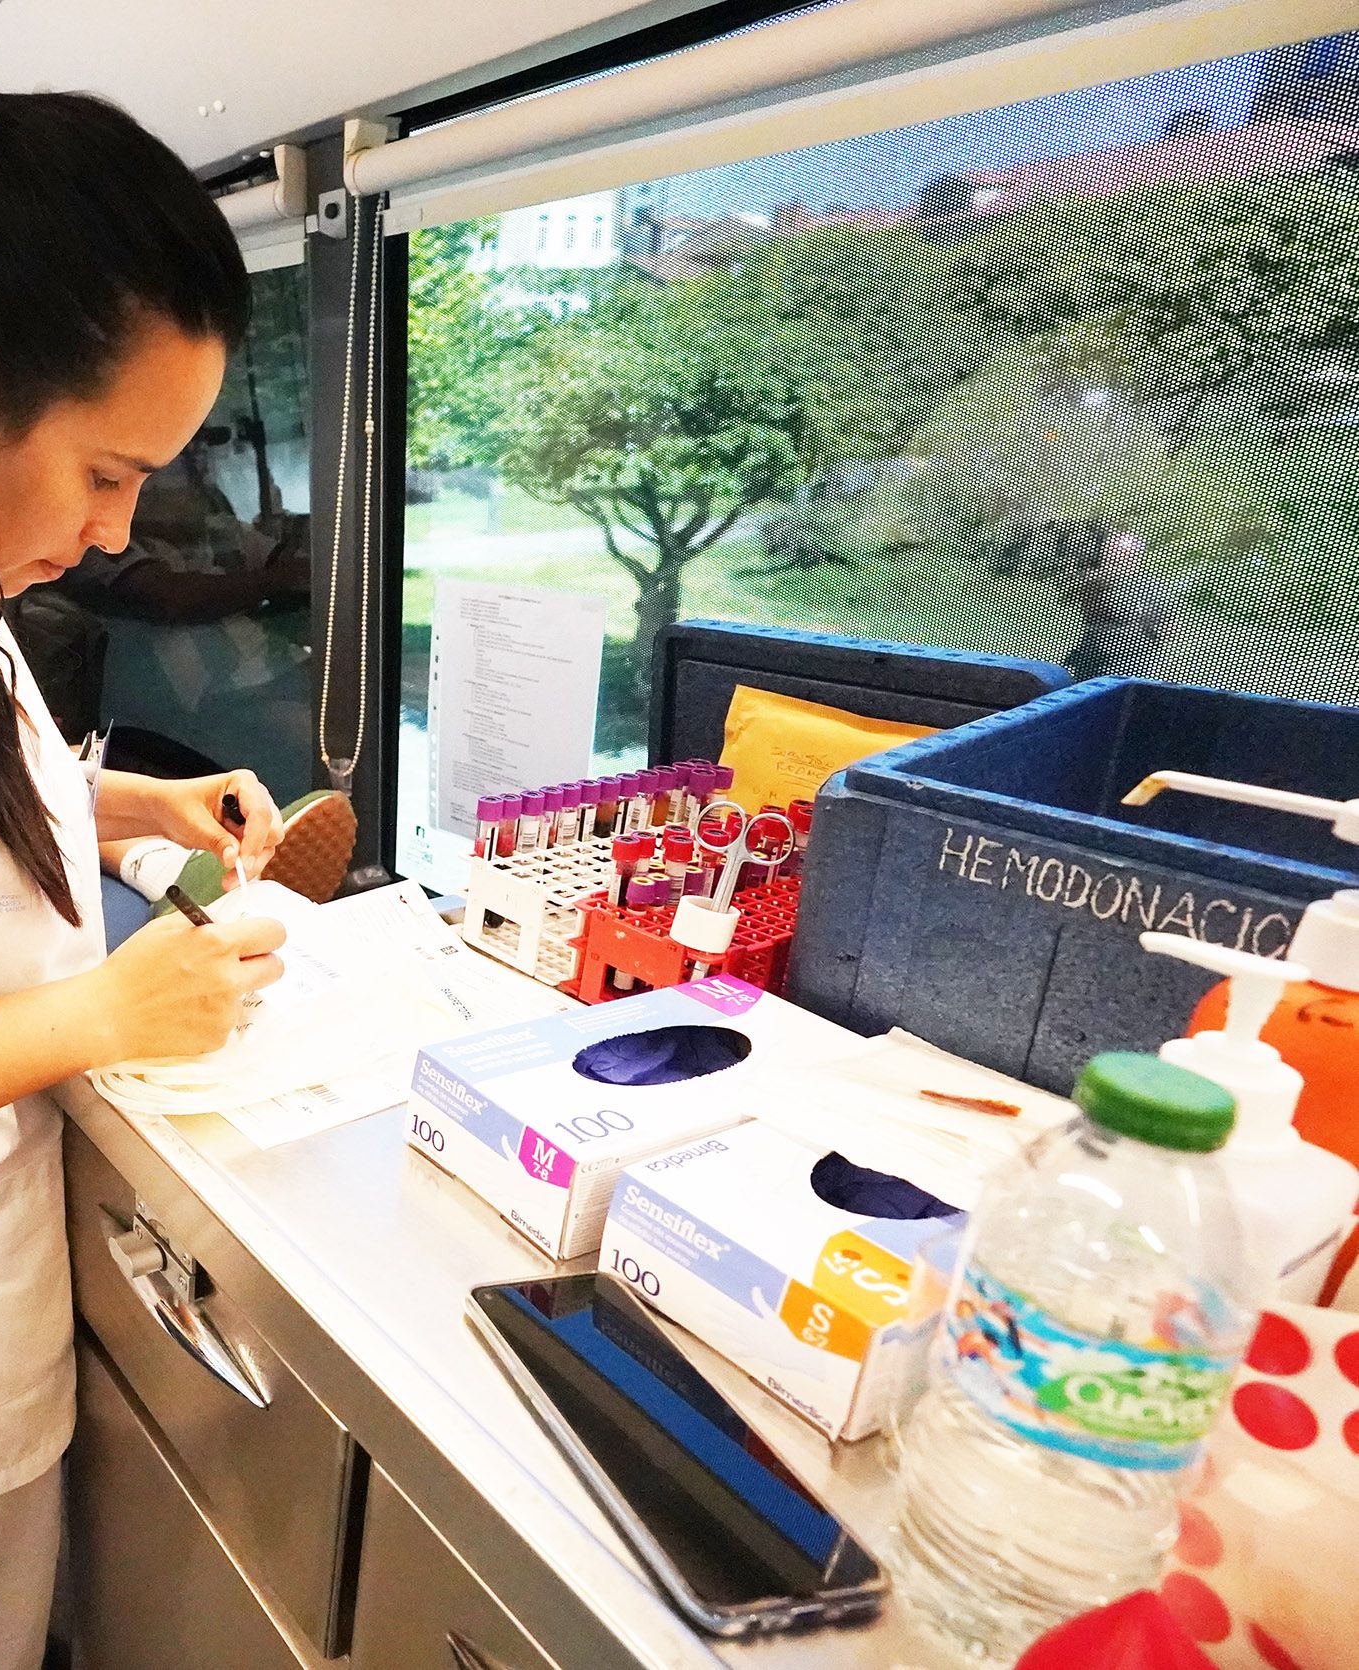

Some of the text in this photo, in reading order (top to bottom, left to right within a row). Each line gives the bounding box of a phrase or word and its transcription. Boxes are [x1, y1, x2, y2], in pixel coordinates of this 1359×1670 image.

[691, 978, 739, 999] M
[419, 1059, 485, 1116] Sensiflex
[411, 1114, 445, 1152] 100
[554, 1109, 635, 1144] 100
[532, 1137, 559, 1172] M
[623, 1184, 725, 1262] Sensiflex
[610, 1248, 660, 1297] 100
[808, 1302, 835, 1333] S
